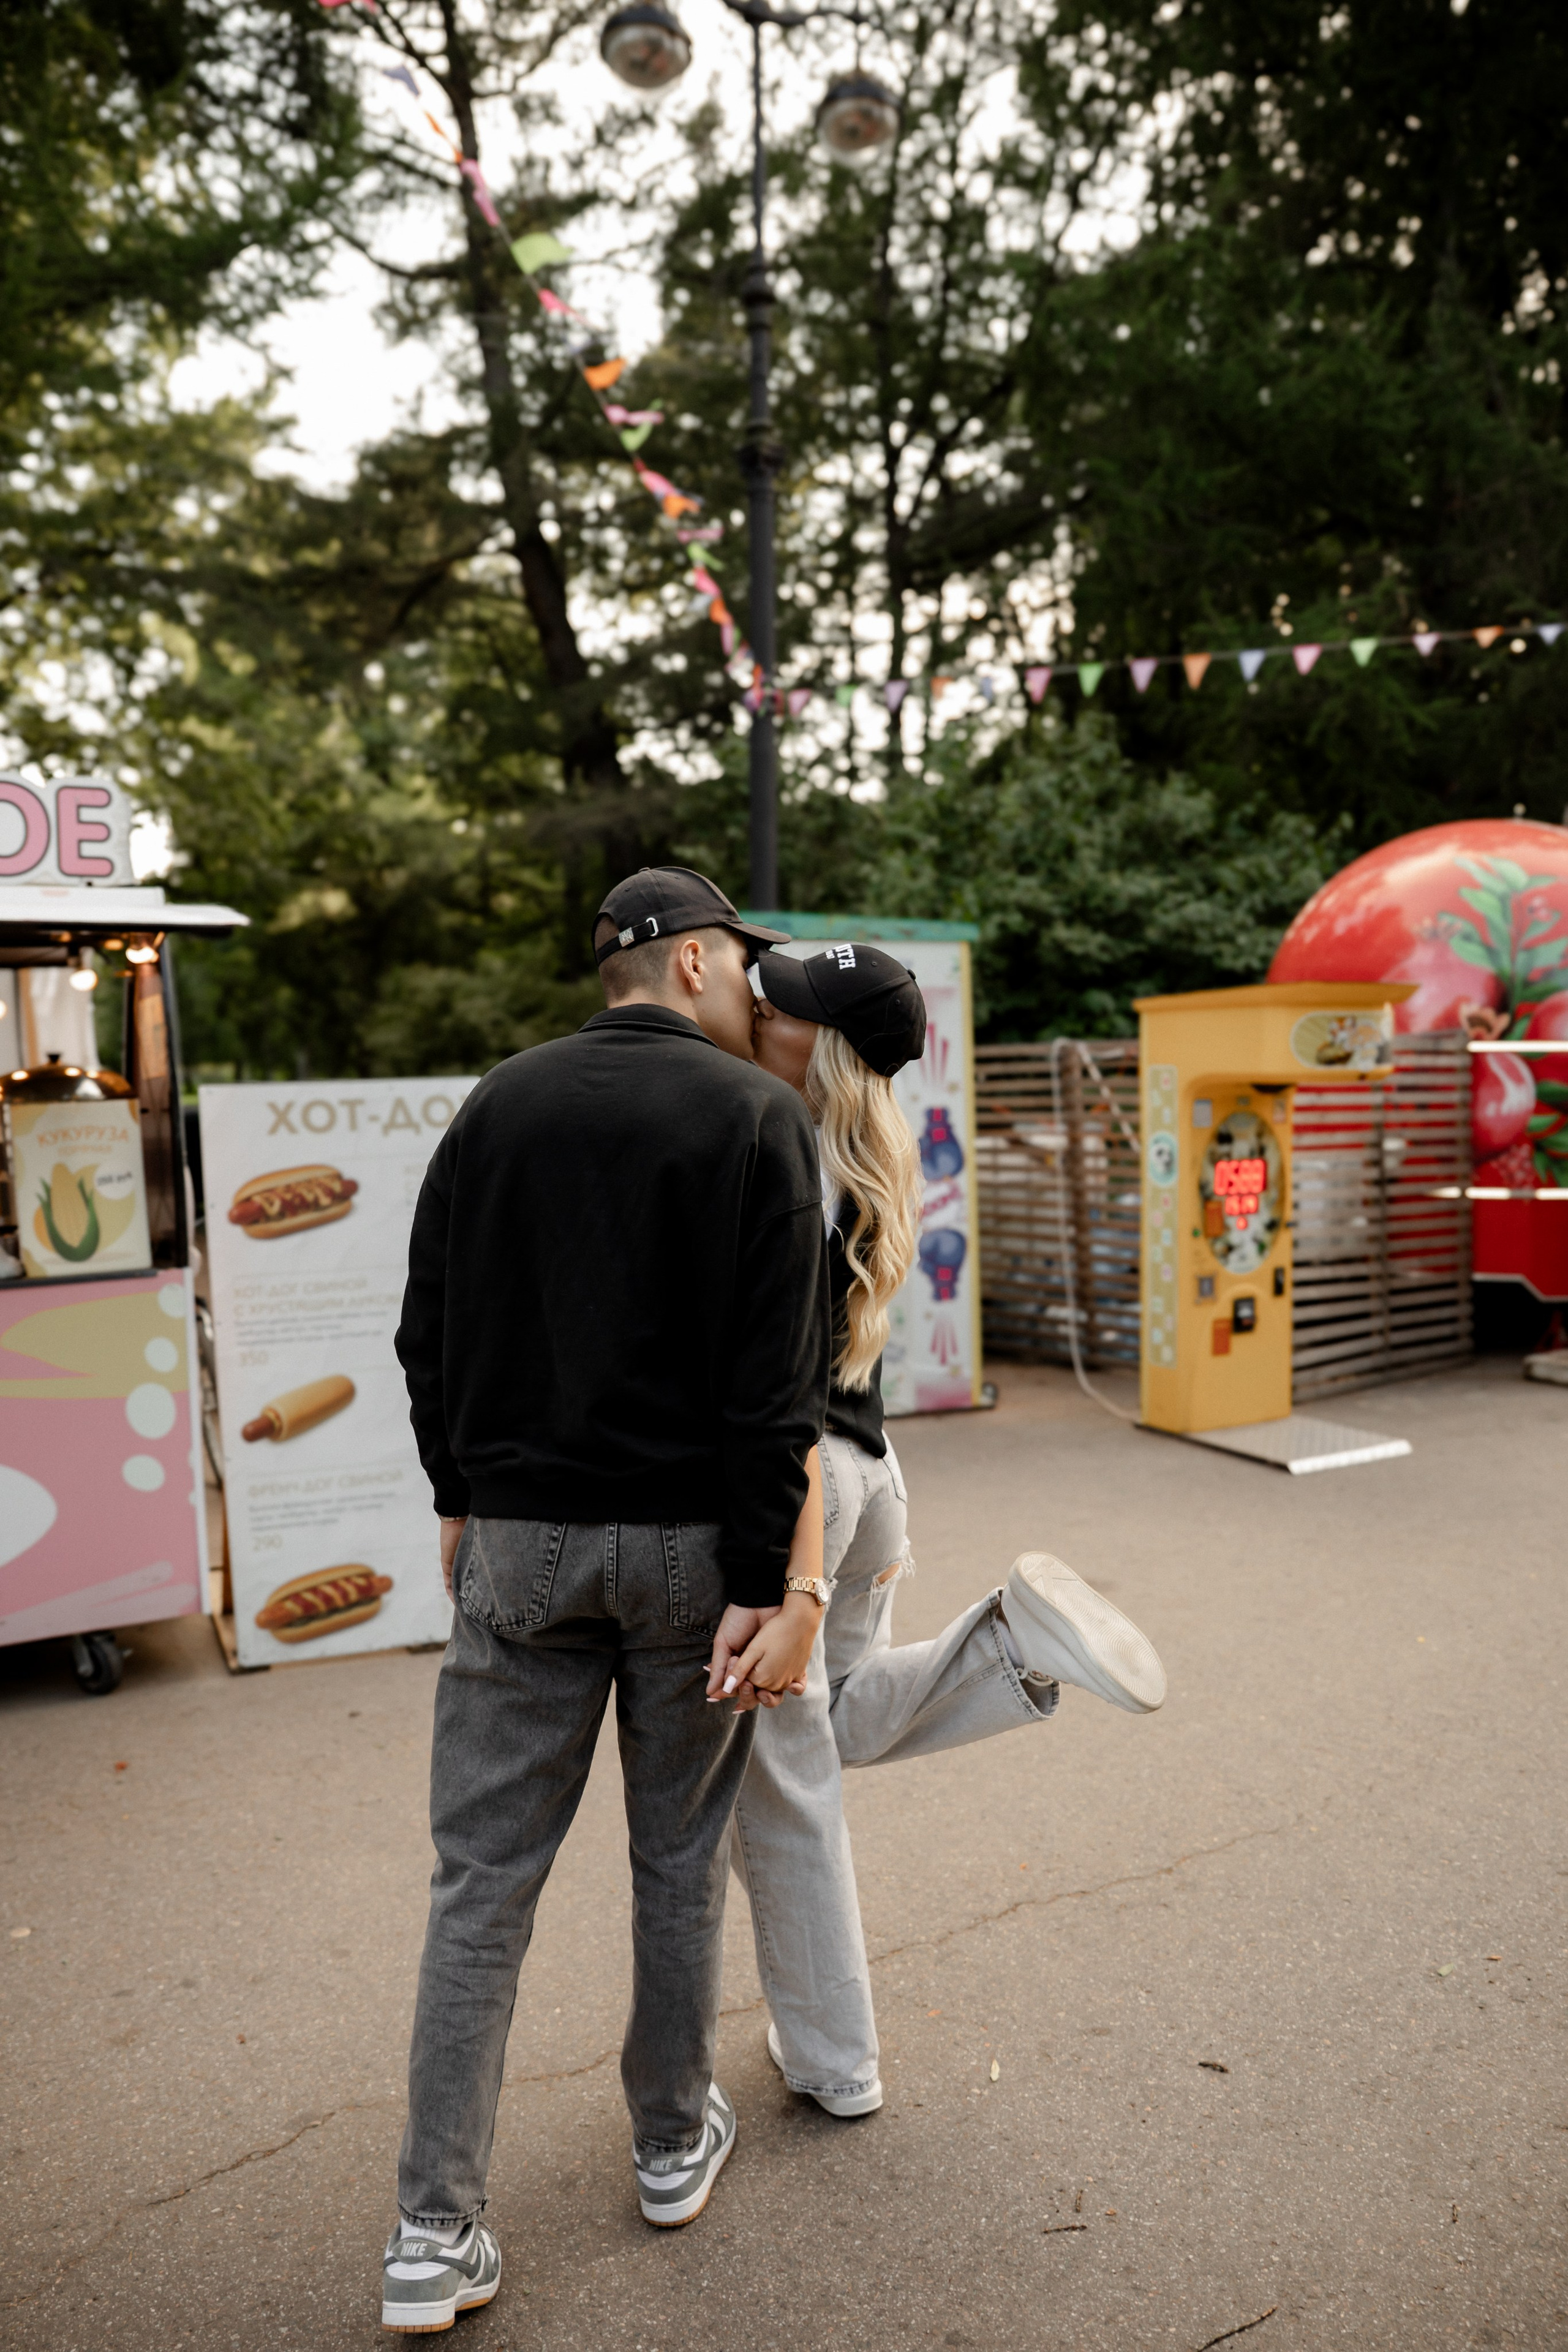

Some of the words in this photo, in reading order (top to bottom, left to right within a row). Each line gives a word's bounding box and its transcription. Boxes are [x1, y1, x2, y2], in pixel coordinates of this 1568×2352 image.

[267, 1094, 469, 1137] ХОТ-ДО
[649, 2158, 673, 2171] NIKE
[400, 2242, 428, 2256] NIKE
